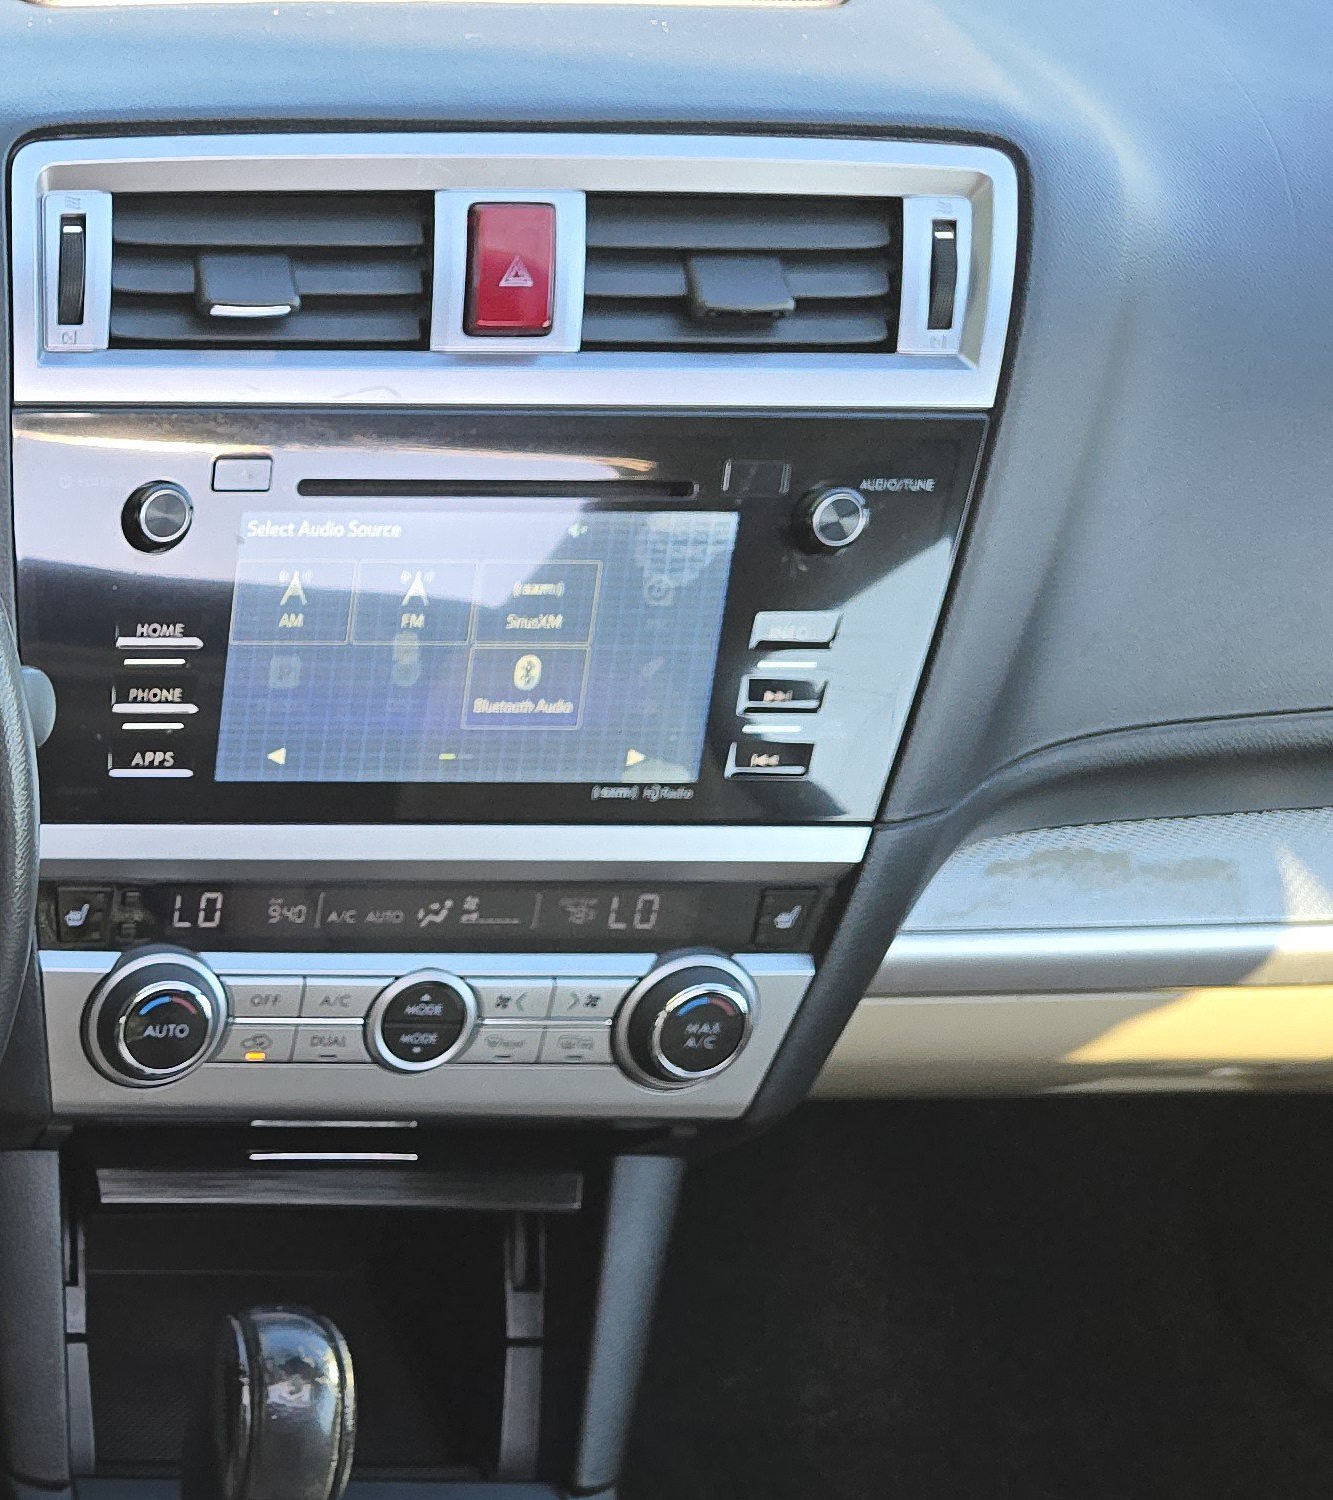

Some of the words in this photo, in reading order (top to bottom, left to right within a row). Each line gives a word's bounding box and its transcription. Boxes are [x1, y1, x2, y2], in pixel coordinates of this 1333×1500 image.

[247, 520, 295, 537] Select
[297, 520, 345, 537] Audio
[347, 520, 402, 538] Source
[278, 613, 304, 628] AM
[401, 613, 425, 628] FM
[136, 623, 185, 638] HOME
[128, 688, 183, 702] PHONE
[473, 698, 534, 713] Bluetooth
[535, 698, 574, 713] Audio
[131, 751, 175, 767] APPS
[171, 892, 224, 928] LO
[327, 910, 357, 923] A/C
[364, 910, 404, 923] AUTO
[607, 893, 661, 930] LO
[250, 994, 281, 1007] OFF
[319, 994, 352, 1008] A/C
[403, 1003, 444, 1016] MODE
[143, 1024, 189, 1039] AUTO
[399, 1032, 439, 1045] MODE
[310, 1035, 346, 1048] DUAL
